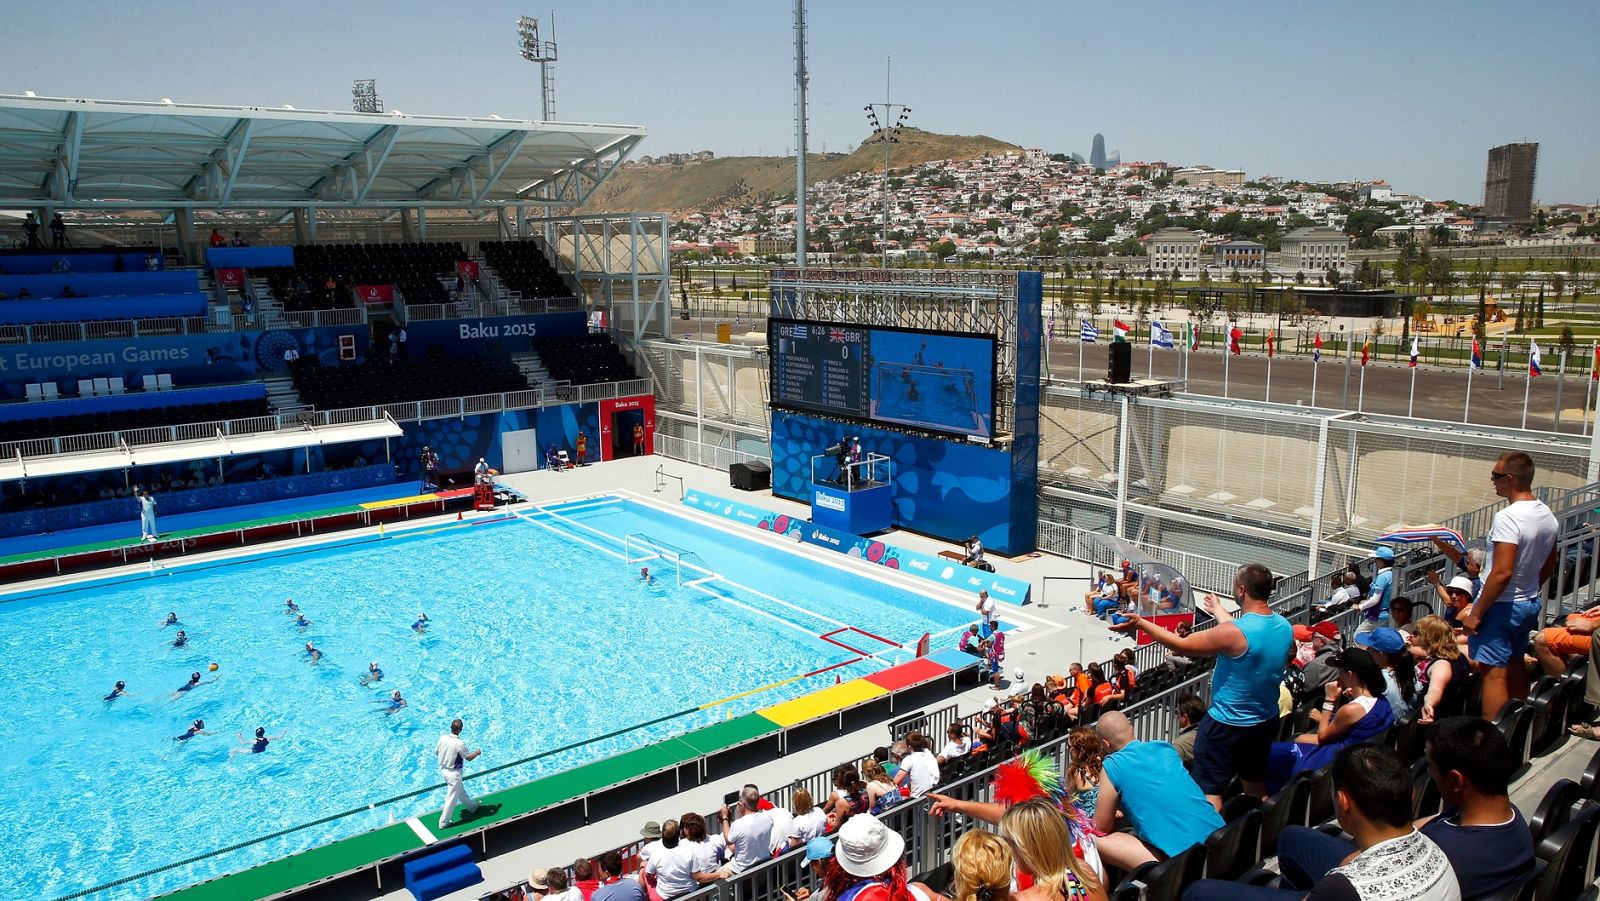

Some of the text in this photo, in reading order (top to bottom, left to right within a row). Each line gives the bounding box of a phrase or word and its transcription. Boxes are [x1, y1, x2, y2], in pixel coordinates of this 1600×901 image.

[459, 322, 536, 339] Baku 2015
[780, 326, 793, 337] GRE
[812, 326, 825, 336] 6:26
[845, 332, 860, 343] GBR
[791, 341, 796, 354] 1
[842, 346, 848, 360] 0
[15, 351, 116, 371] European
[122, 346, 189, 362] Games
[816, 491, 831, 503] Baku
[831, 498, 844, 507] 2015
[818, 533, 840, 546] Baku 2015
[997, 587, 1016, 596] SOCAR
